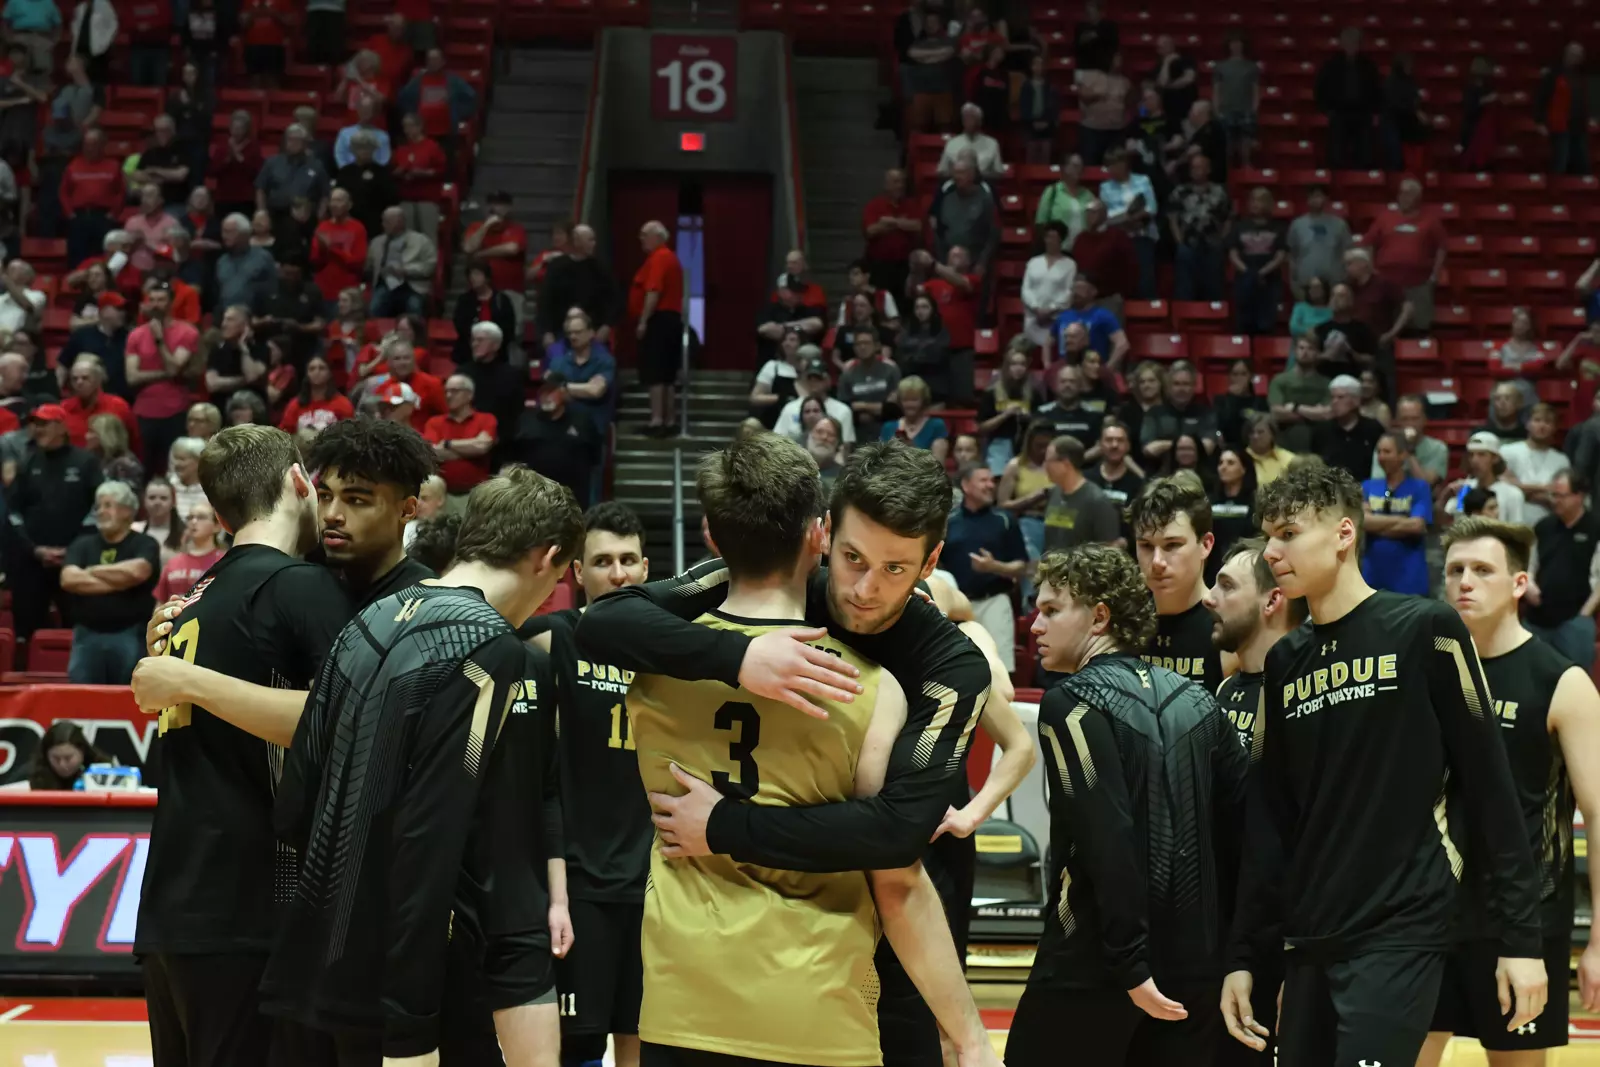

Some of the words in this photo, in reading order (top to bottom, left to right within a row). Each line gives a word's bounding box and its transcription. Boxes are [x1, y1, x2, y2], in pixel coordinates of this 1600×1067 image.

[656, 60, 726, 113] 18
[592, 680, 618, 693] FORT
[1283, 653, 1398, 709] PURDUE
[1296, 695, 1325, 719] FORT
[1326, 683, 1376, 706] WAYNE
[710, 701, 761, 800] 3
[977, 907, 1005, 917] BALL
[560, 992, 577, 1017] 11
